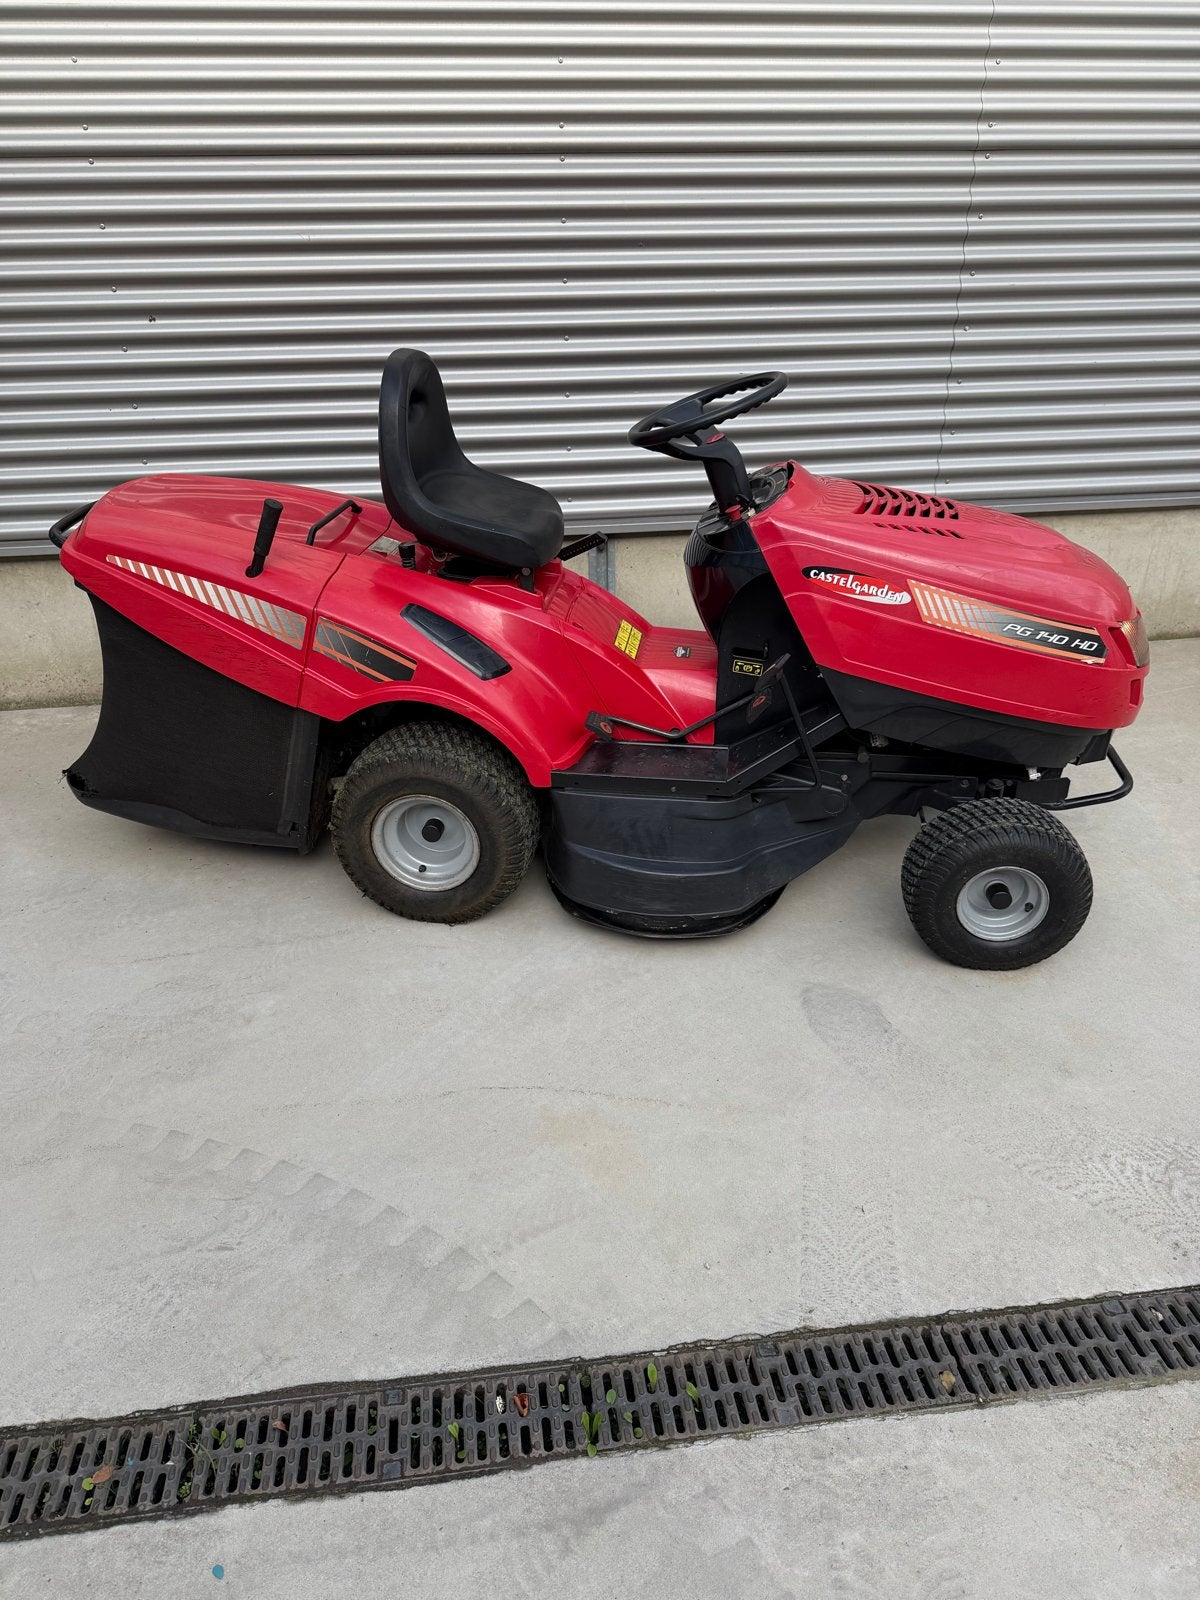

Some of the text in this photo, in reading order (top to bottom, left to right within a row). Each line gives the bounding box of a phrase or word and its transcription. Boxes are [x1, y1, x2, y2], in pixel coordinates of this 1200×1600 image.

[1002, 623, 1098, 651] PG 140 HD
